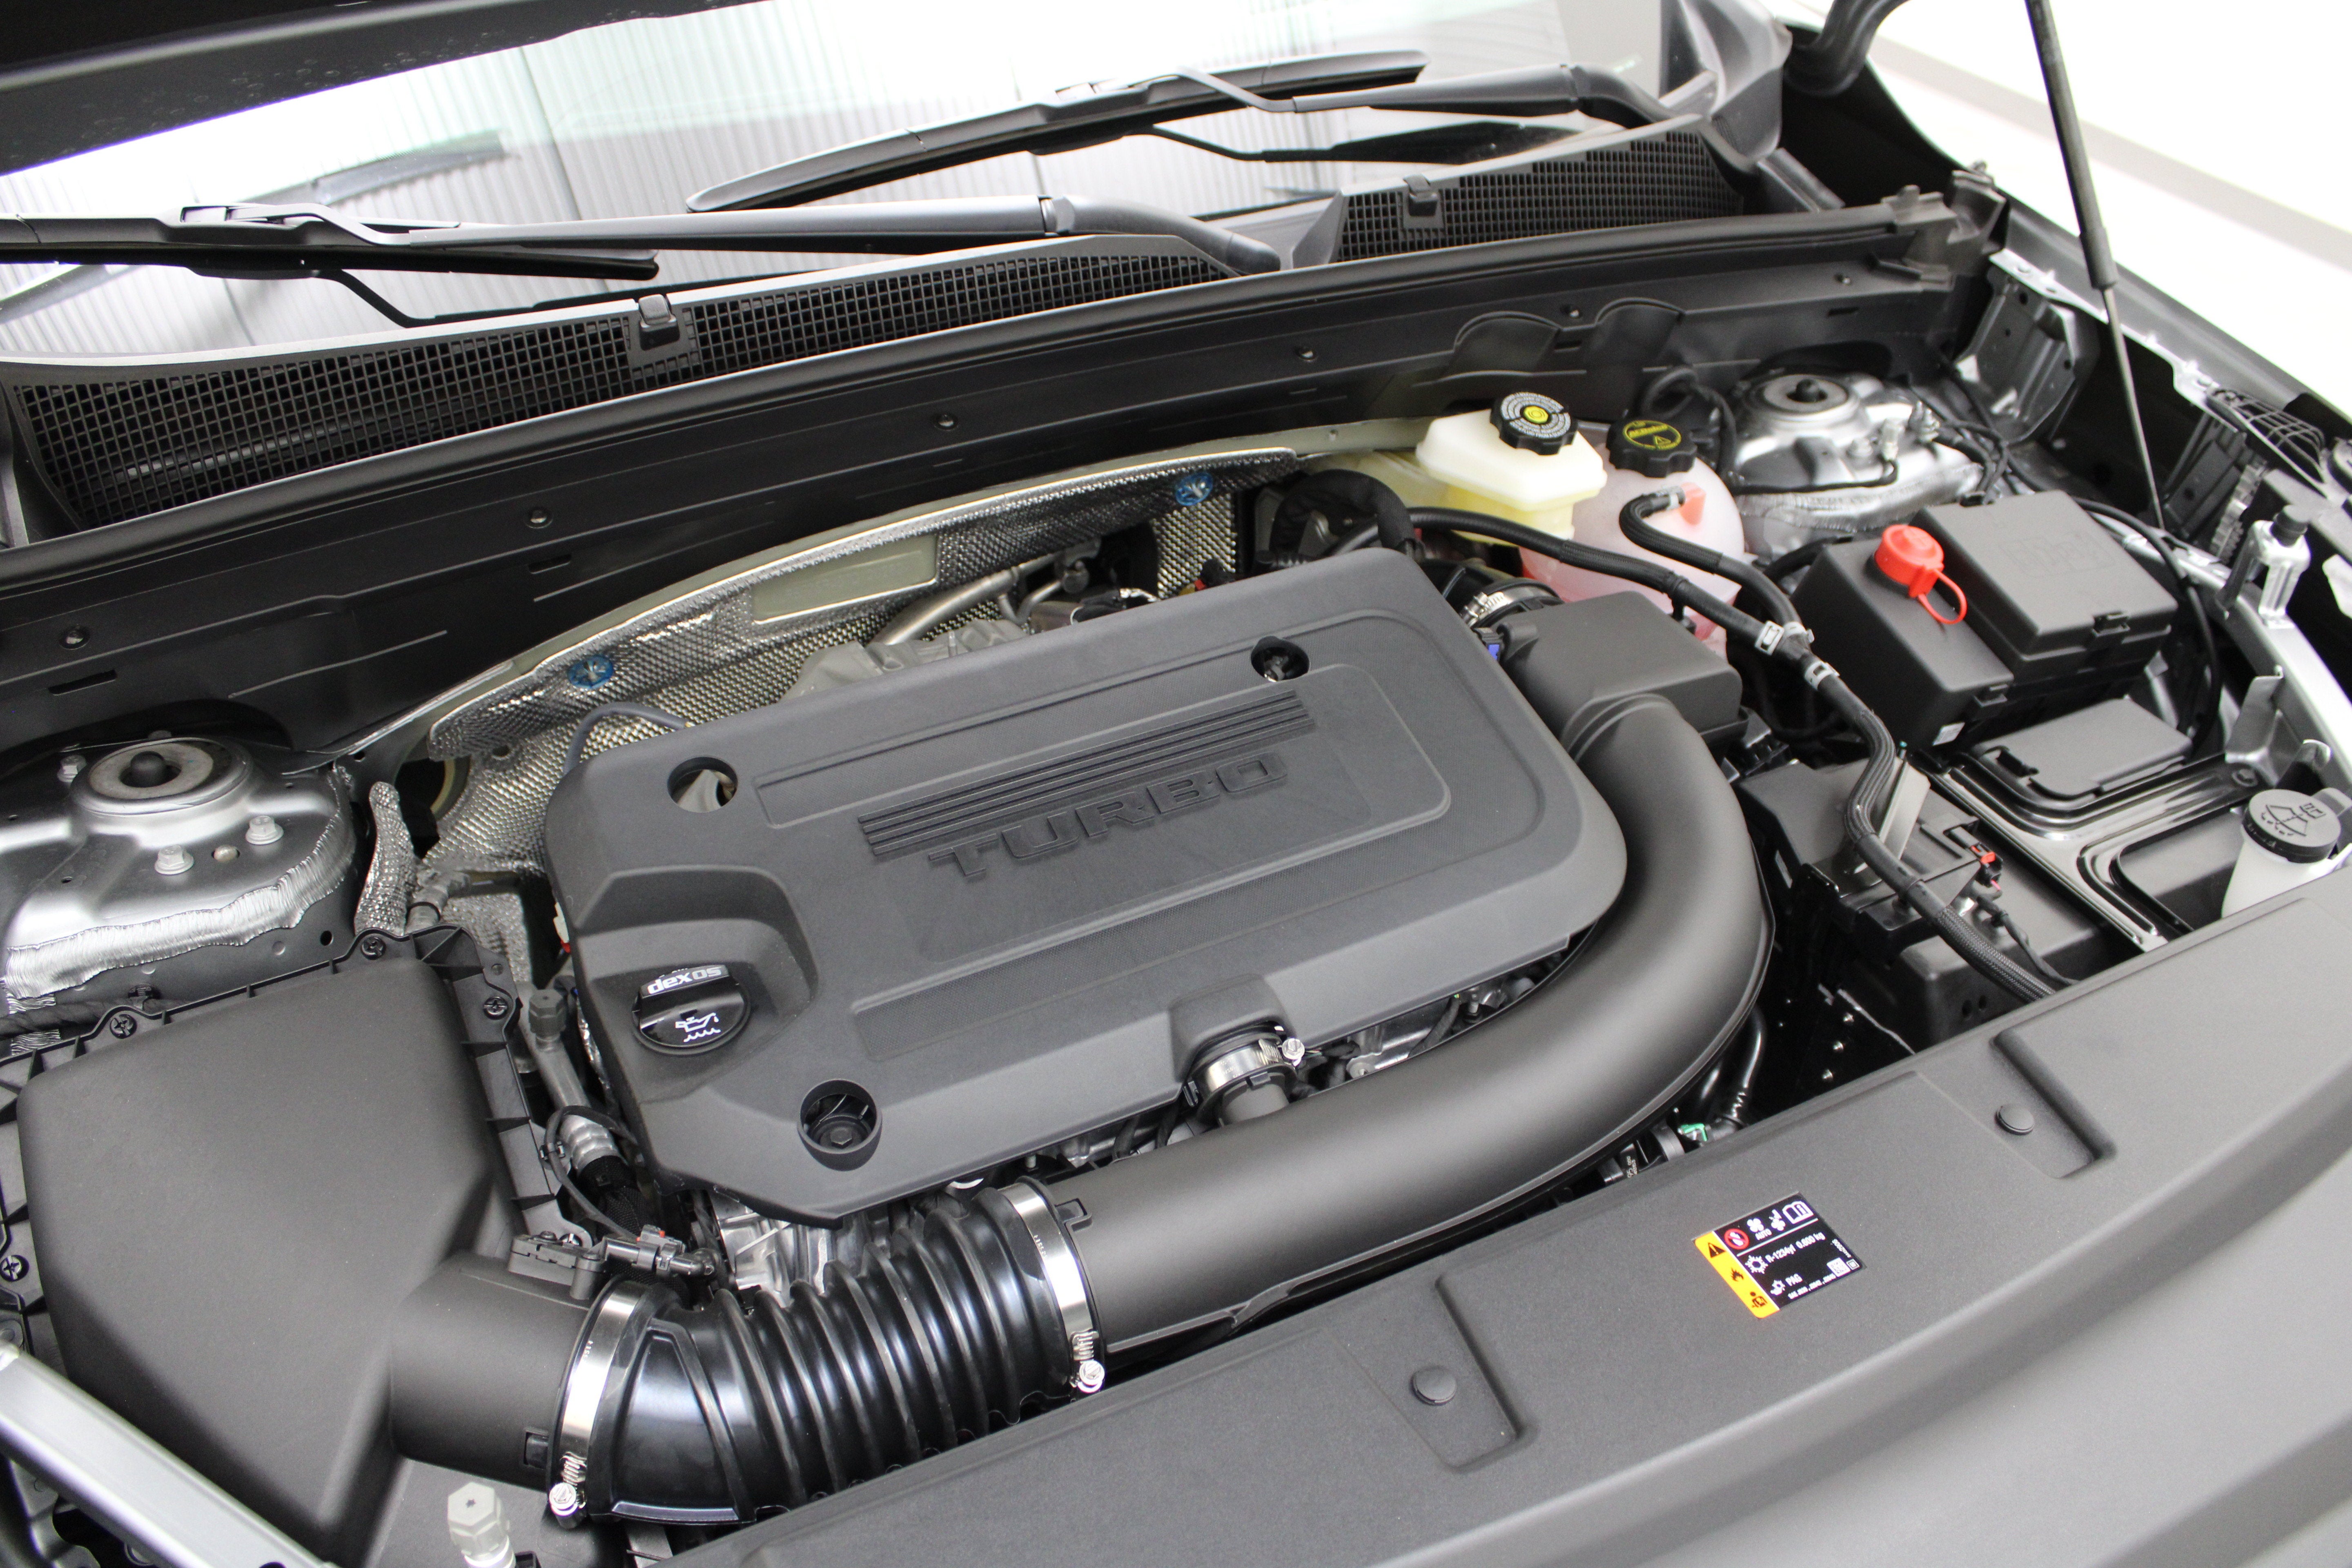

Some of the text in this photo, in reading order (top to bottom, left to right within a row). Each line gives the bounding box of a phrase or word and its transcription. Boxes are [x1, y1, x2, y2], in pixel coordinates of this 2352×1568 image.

[928, 752, 1288, 880] TURBO
[647, 967, 722, 994] dexos
[1755, 1229, 1772, 1240] AUTO
[1765, 1244, 1796, 1263] R-1234yf
[1785, 1274, 1802, 1286] PAG
